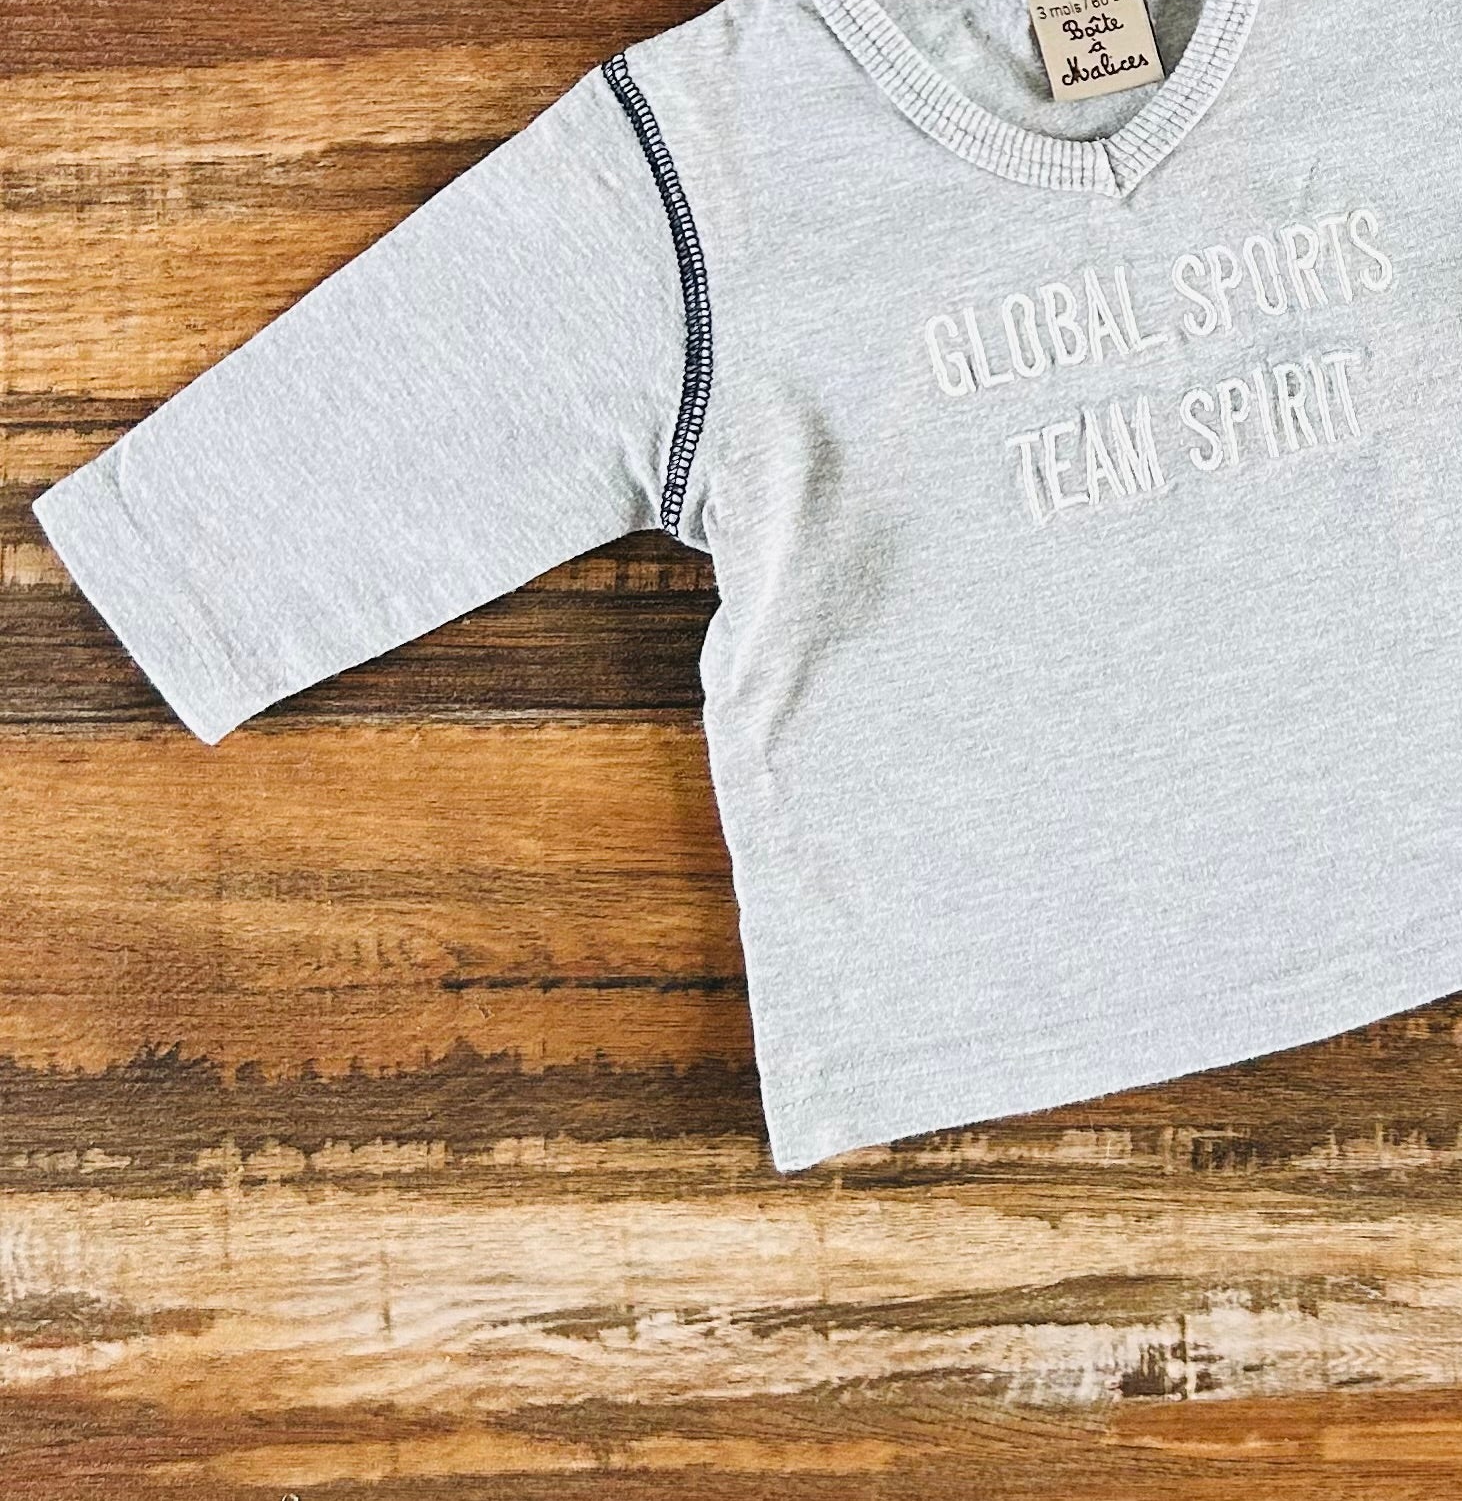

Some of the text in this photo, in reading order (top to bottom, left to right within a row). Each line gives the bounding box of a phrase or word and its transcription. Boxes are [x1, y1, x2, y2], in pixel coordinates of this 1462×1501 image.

[1036, 6, 1047, 19] 3
[1050, 2, 1082, 18] mois
[1062, 13, 1124, 40] Boîte
[1088, 38, 1106, 53] à
[1062, 53, 1149, 86] Malices
[925, 209, 1393, 397] GLOBAL SPORTS
[1005, 349, 1362, 527] TEAM SPIRIT
